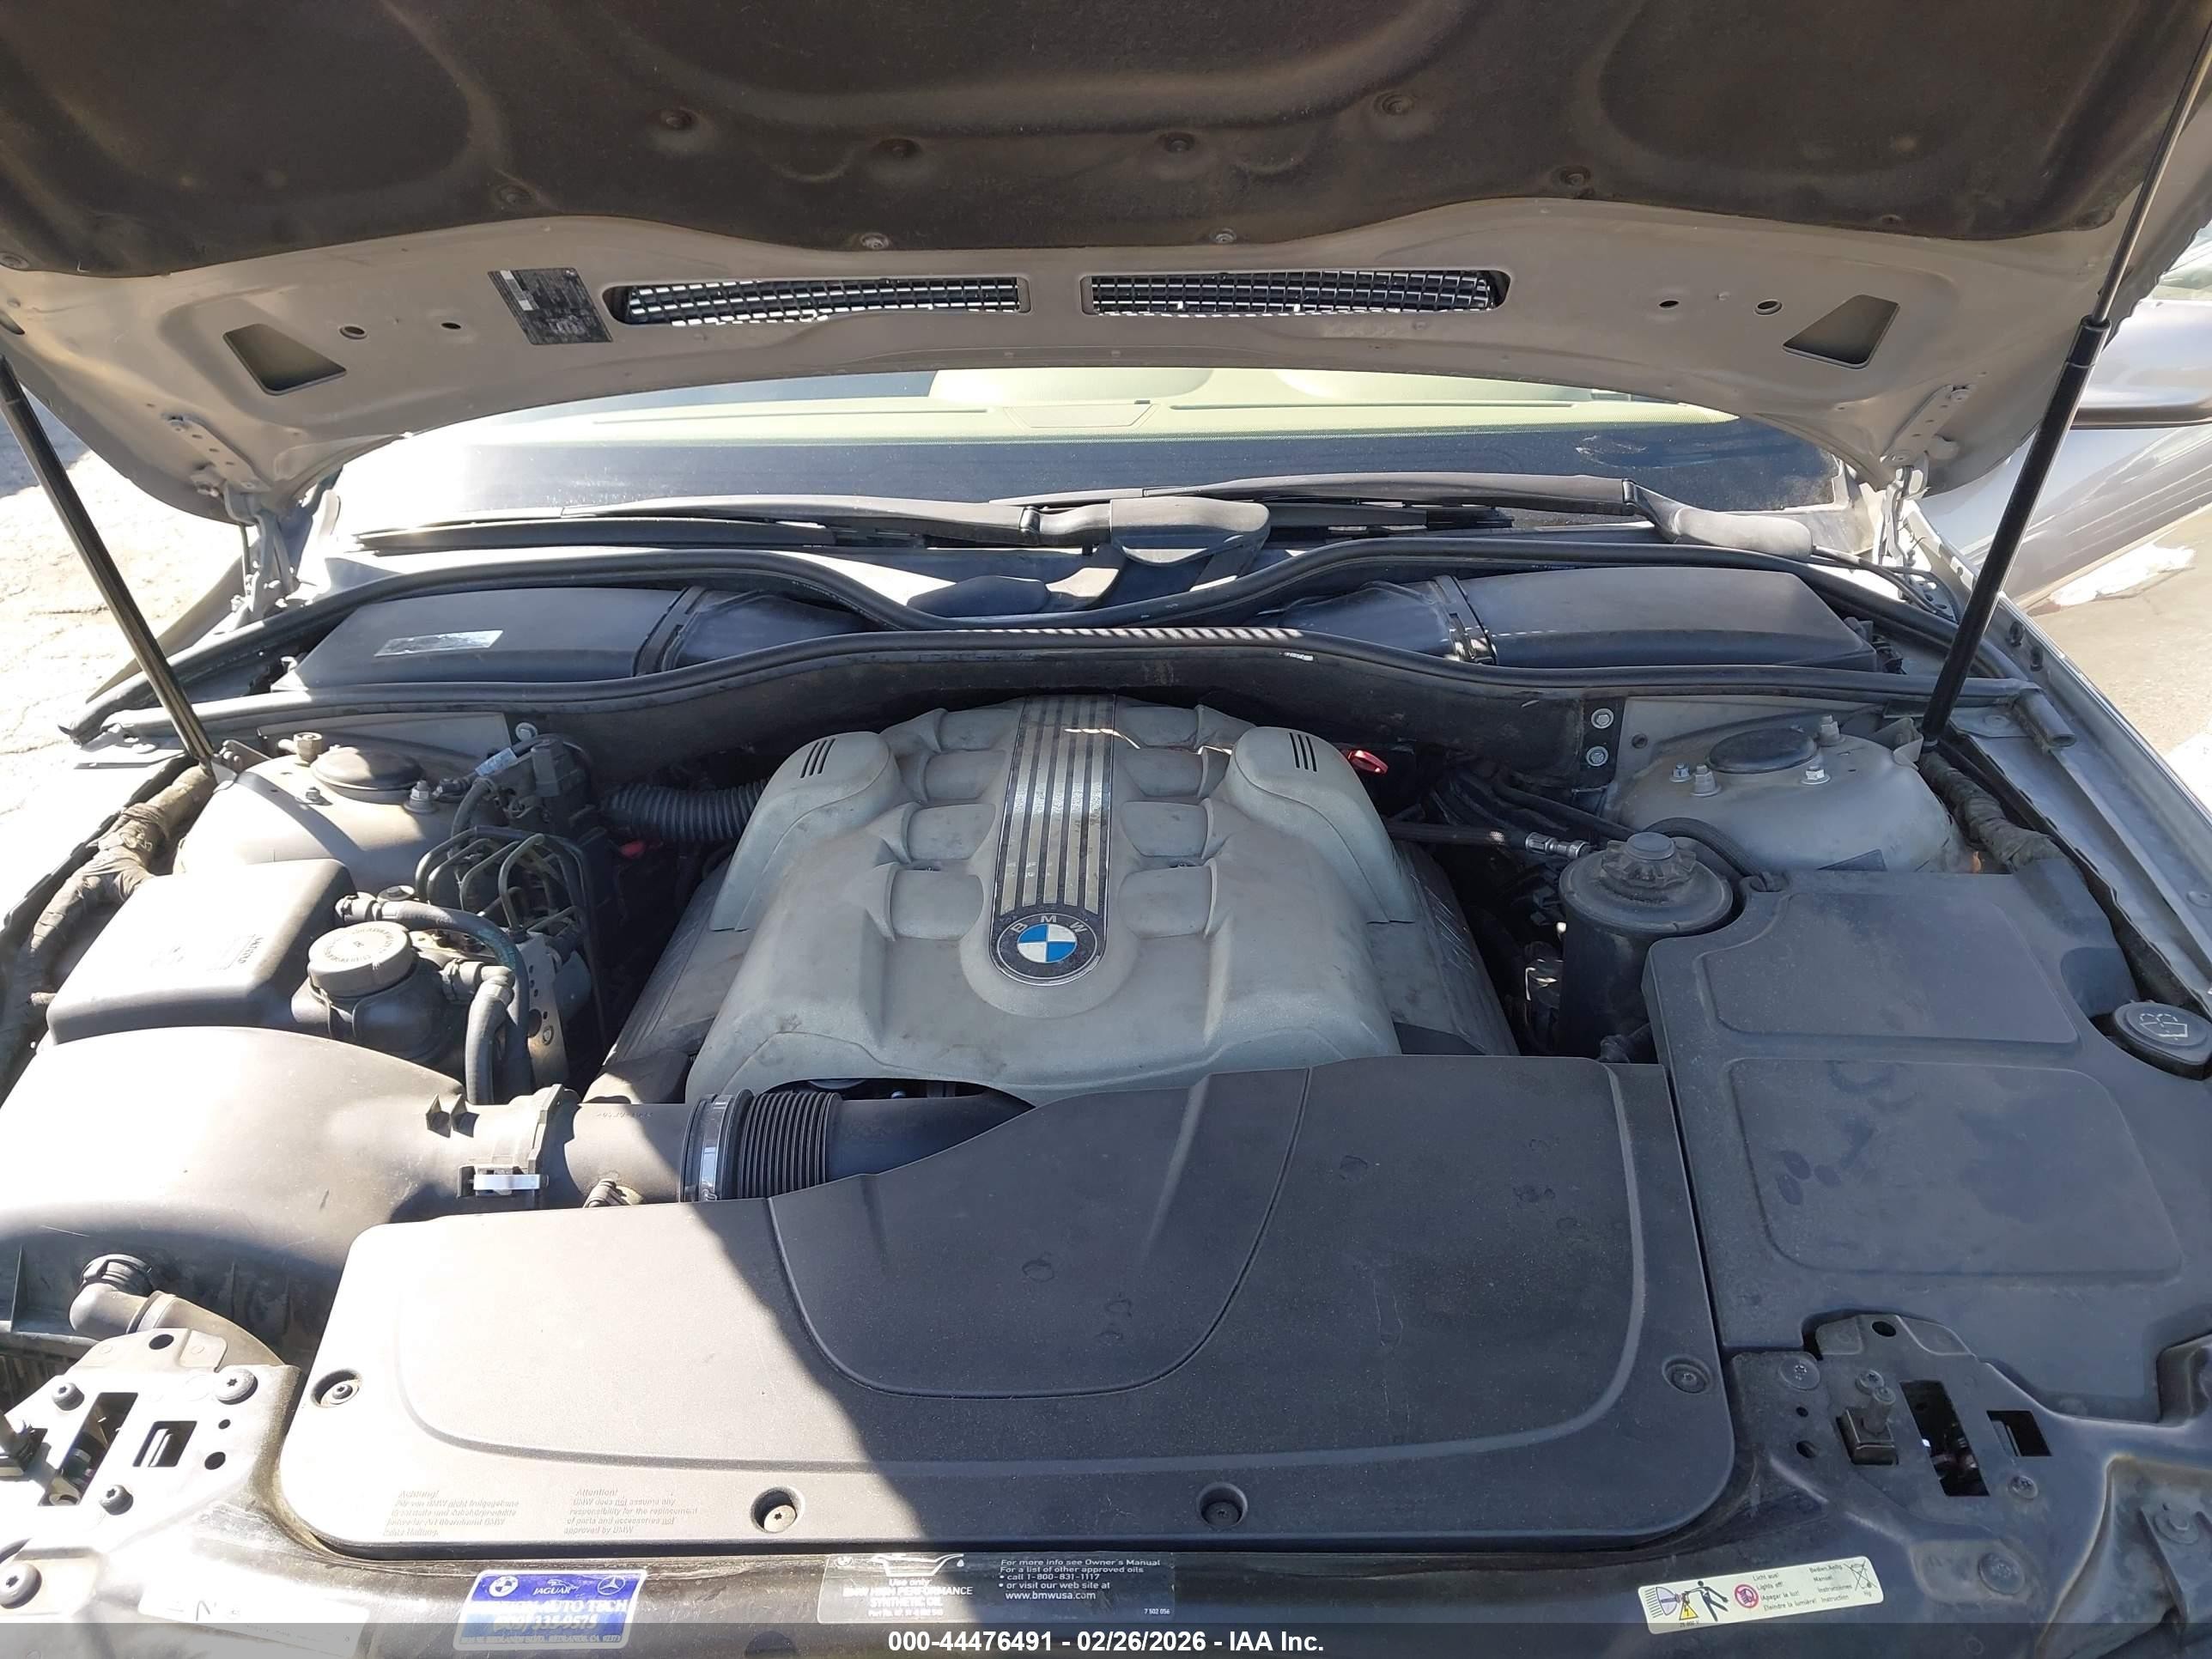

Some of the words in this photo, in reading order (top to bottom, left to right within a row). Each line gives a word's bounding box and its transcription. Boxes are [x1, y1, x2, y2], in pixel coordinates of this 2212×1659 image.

[1010, 915, 1087, 933] BMW
[569, 1507, 620, 1516] responsibility
[649, 1507, 698, 1516] replacement
[567, 1517, 575, 1526] of
[563, 1526, 600, 1534] approved
[602, 1526, 611, 1534] by
[909, 1578, 930, 1588] only
[1756, 1583, 1774, 1591] Lights
[896, 1587, 972, 1596] PERFORMANCE
[1006, 1591, 1096, 1600] www.bmwusa.com
[588, 1600, 629, 1613] TECH
[869, 1597, 926, 1607] SYNTHETIC
[927, 1597, 944, 1607] OIL
